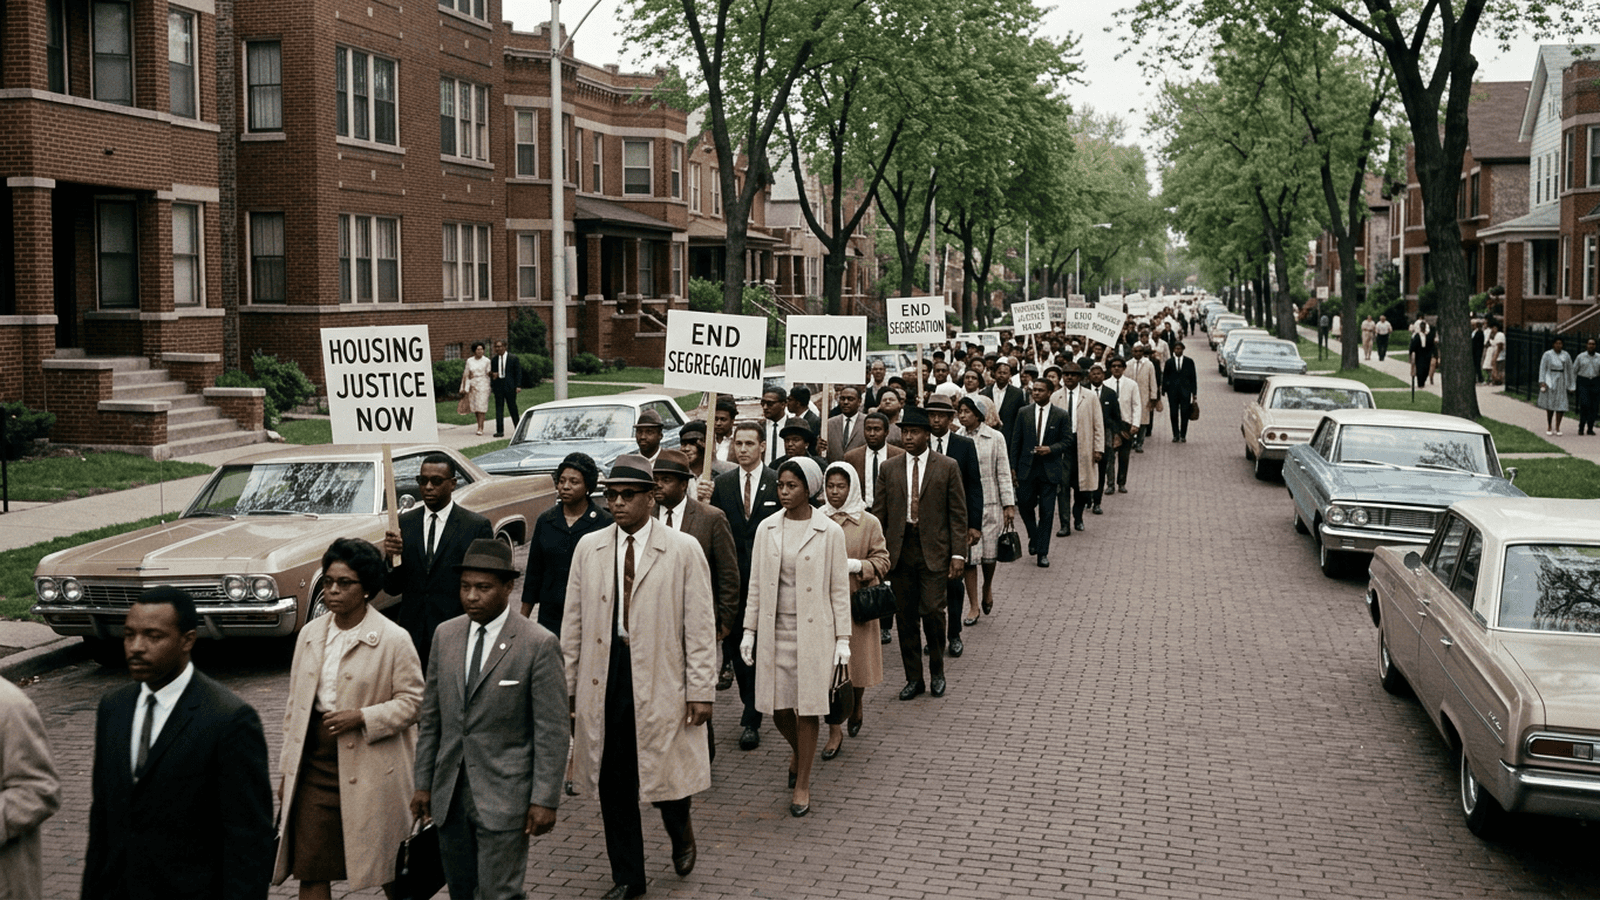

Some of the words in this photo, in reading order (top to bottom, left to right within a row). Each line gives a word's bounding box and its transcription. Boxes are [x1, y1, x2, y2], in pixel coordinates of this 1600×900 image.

[902, 303, 930, 316] END
[692, 323, 740, 347] END
[890, 320, 944, 334] SEGREGATION
[329, 337, 423, 364] HOUSING
[790, 334, 862, 362] FREEDOM
[668, 351, 761, 380] SEGREGATION
[337, 372, 427, 398] JUSTICE
[356, 407, 414, 431] NOW
